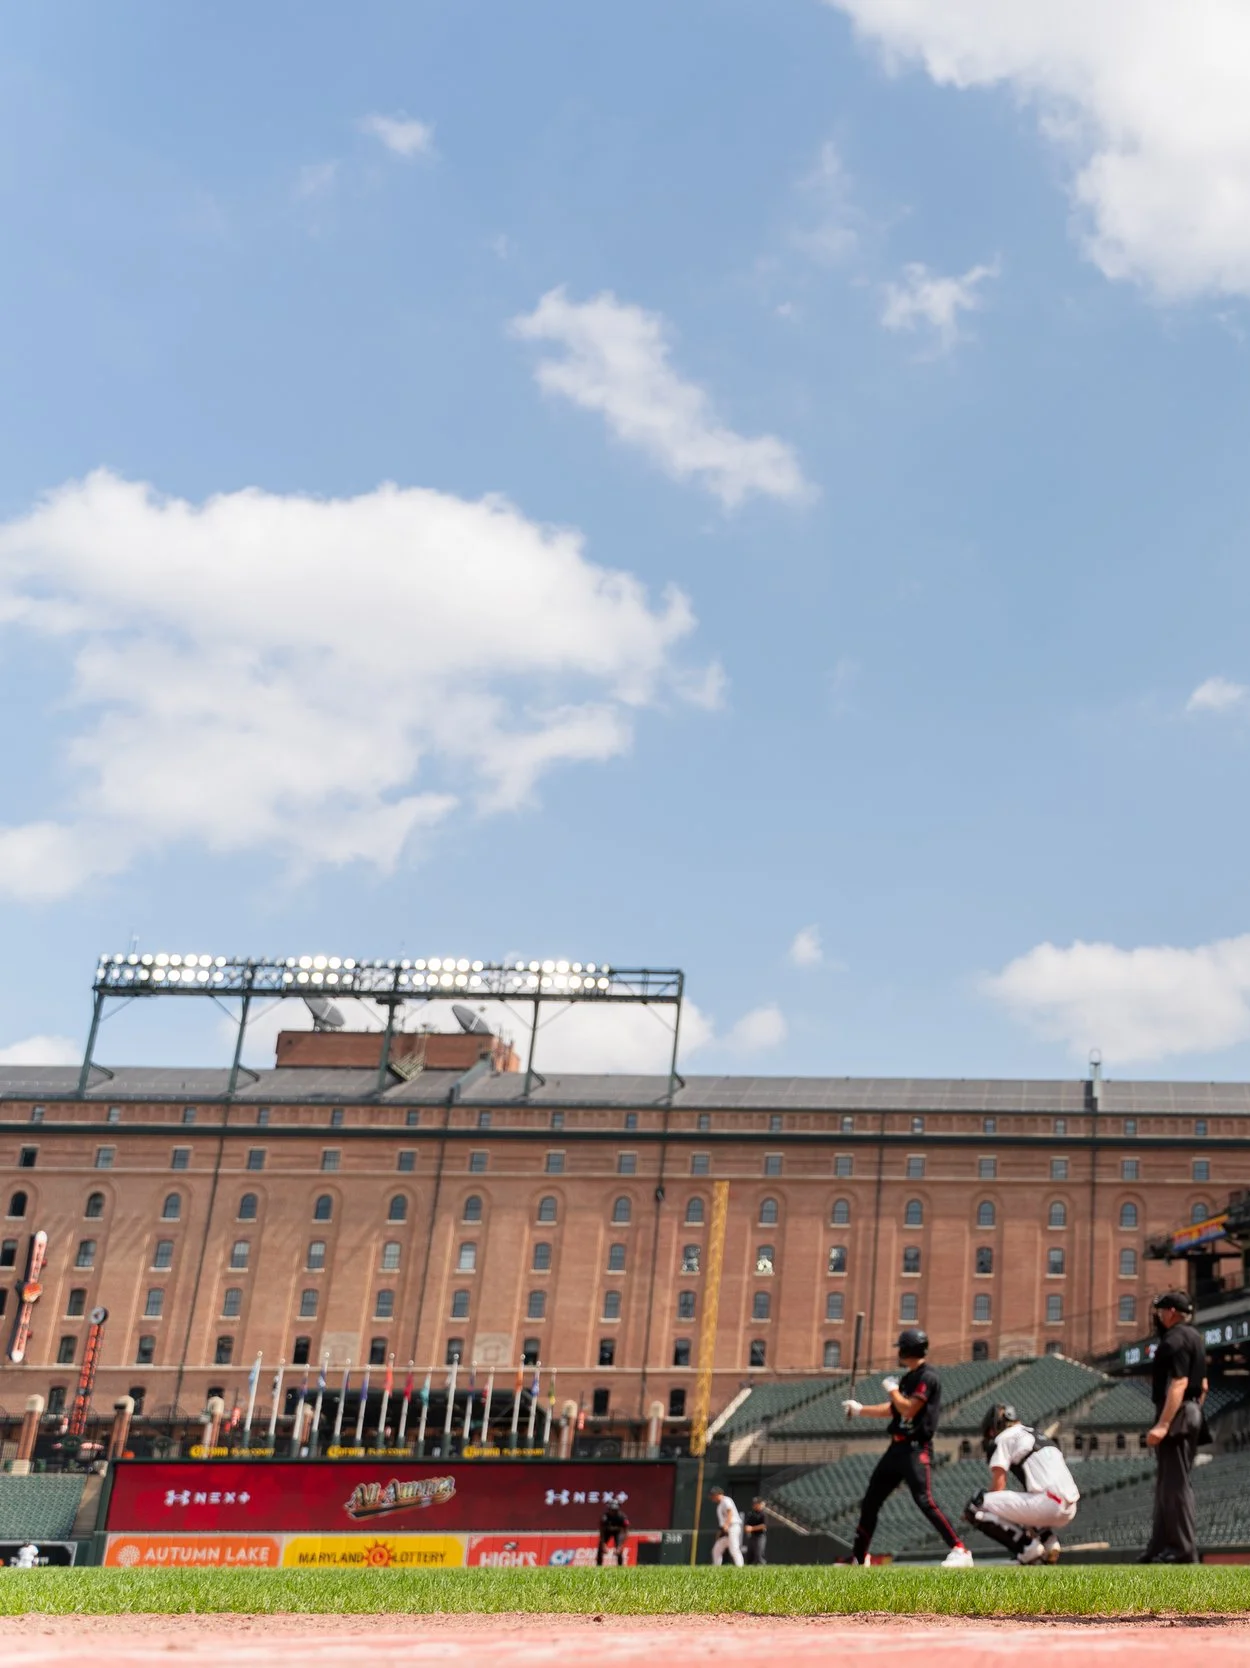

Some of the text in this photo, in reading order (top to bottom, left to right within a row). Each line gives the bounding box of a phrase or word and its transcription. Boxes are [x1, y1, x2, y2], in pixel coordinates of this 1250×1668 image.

[144, 1545, 270, 1563] AUTUMN LAKE
[298, 1551, 447, 1565] MARYLAND LOTTERY
[479, 1550, 538, 1567] HIGH'S
